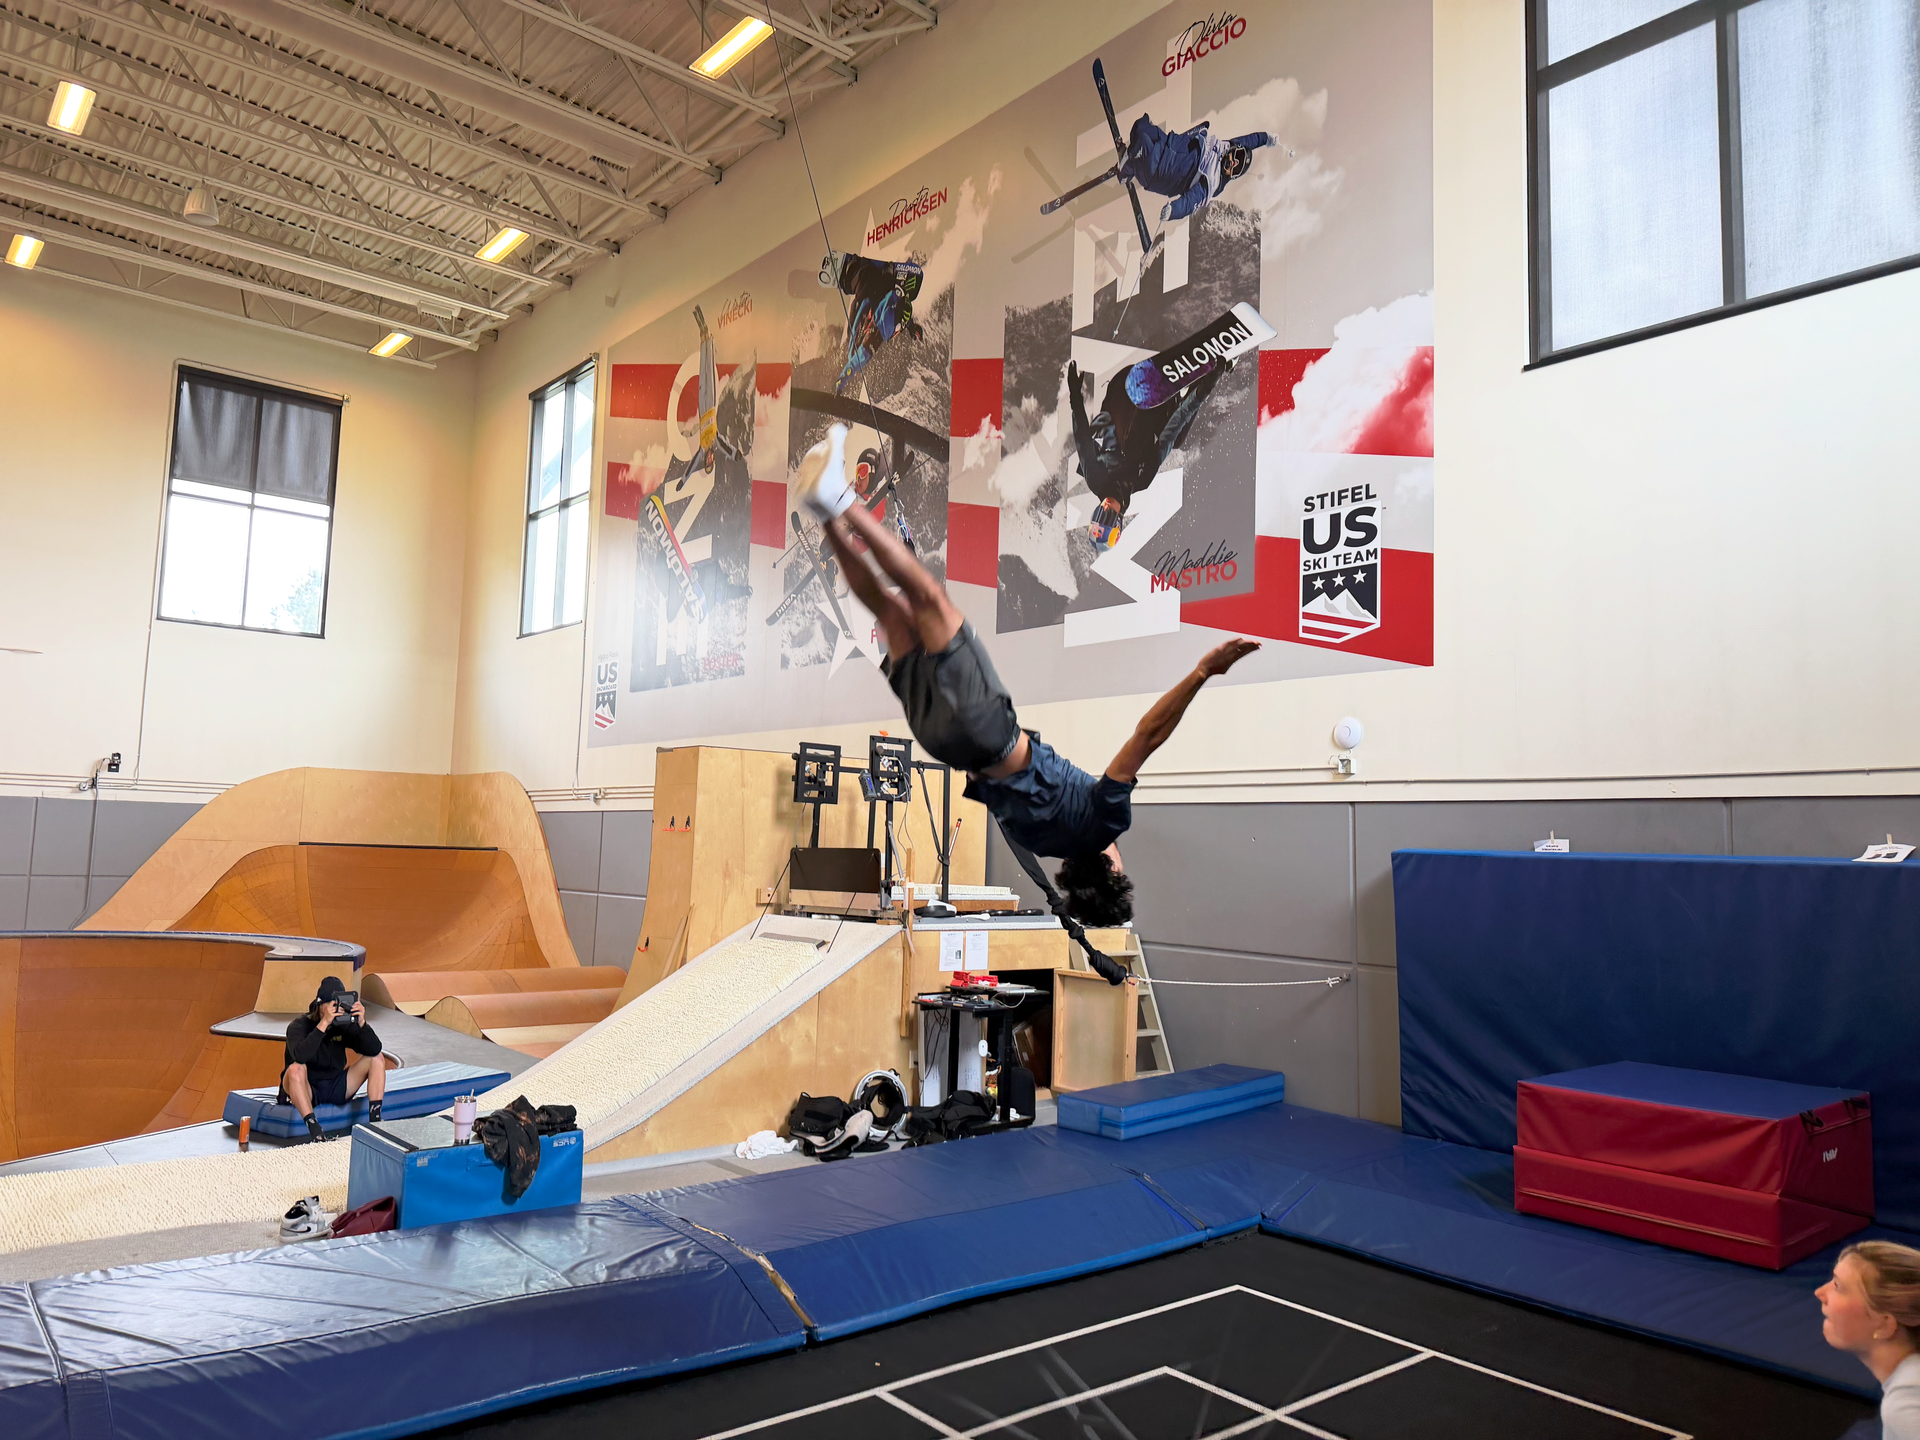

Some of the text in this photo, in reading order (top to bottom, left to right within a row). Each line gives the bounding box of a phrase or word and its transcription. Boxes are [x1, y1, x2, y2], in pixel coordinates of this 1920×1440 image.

[1161, 17, 1247, 77] GIACCIO
[1175, 11, 1237, 57] Olivia
[866, 187, 948, 246] HENRICKSEN
[895, 264, 922, 275] SALOMON
[717, 299, 753, 330] VINECKI
[1161, 321, 1254, 384] SALOMON
[1302, 483, 1377, 512] STIFEL
[1302, 506, 1379, 555] US
[645, 500, 707, 625] SALOMON
[1150, 560, 1238, 594] MASTRO
[1154, 539, 1239, 588] Maddie
[1302, 548, 1378, 572] SKI TEAM
[597, 662, 618, 685] US
